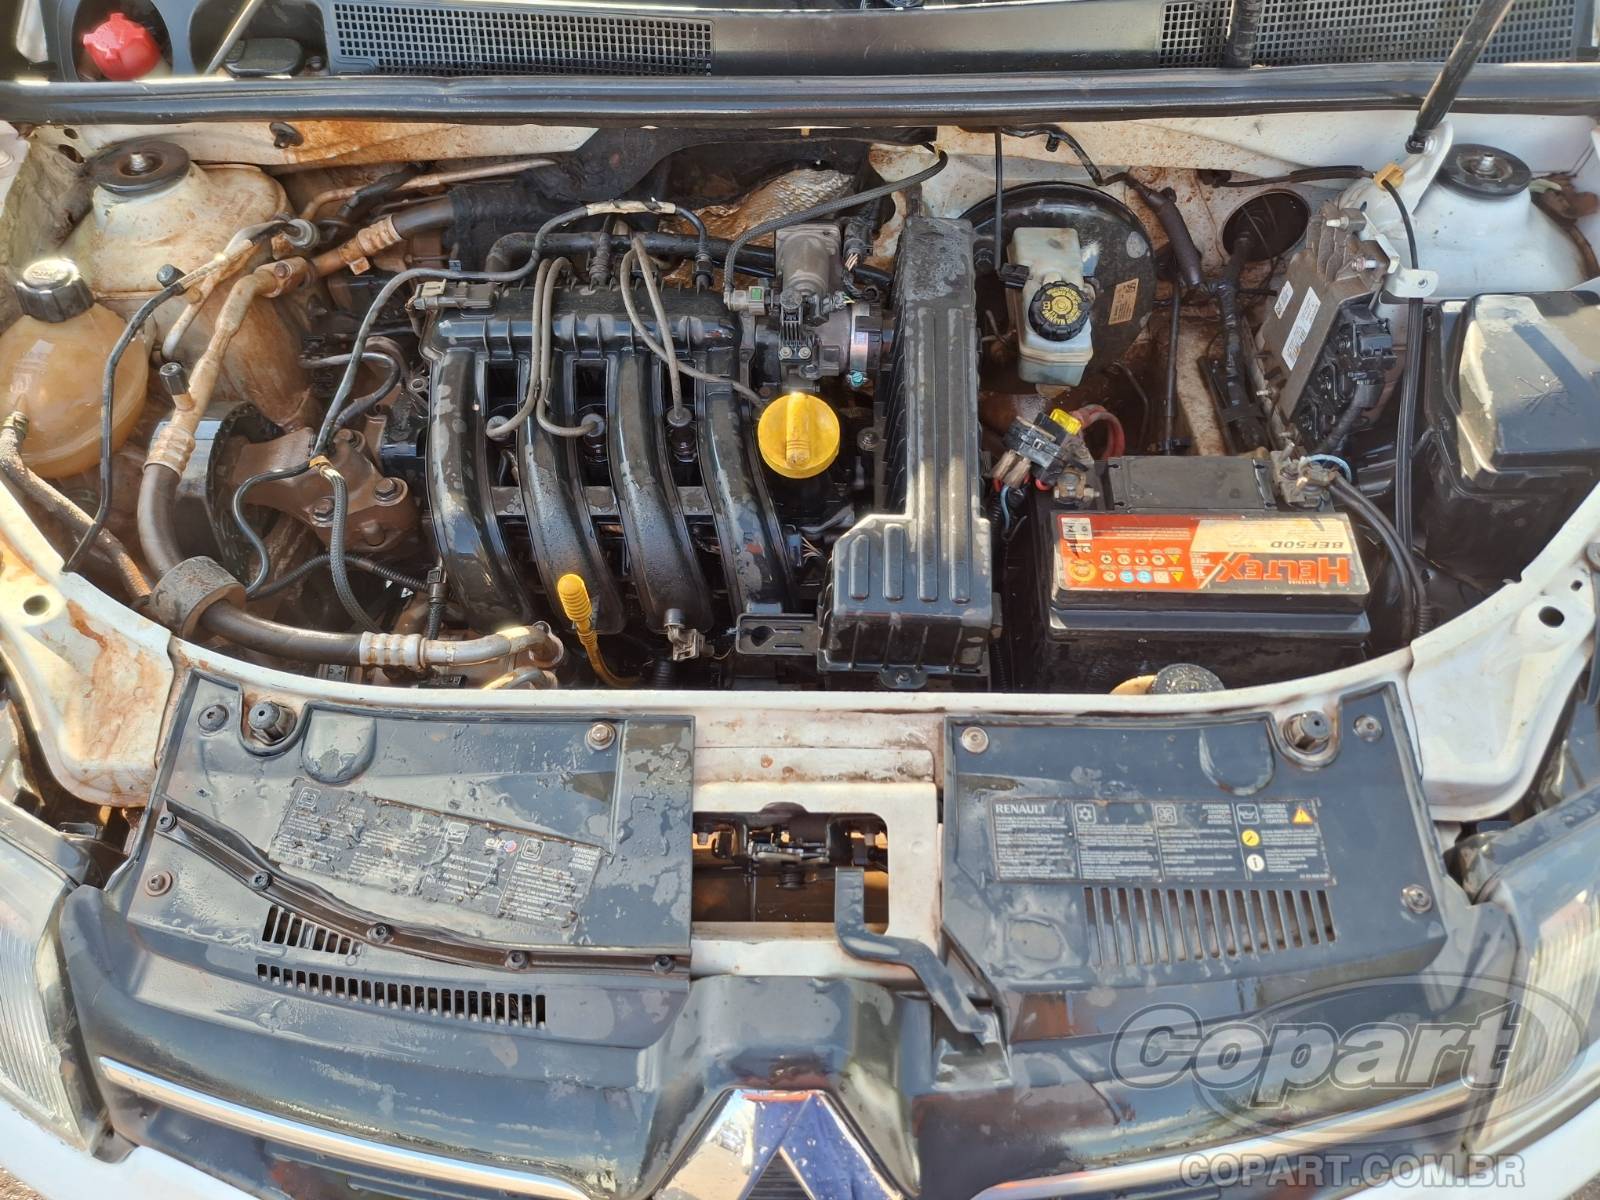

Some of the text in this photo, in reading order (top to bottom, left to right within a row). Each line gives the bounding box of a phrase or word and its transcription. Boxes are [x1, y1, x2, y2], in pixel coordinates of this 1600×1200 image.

[1270, 541, 1344, 549] BEF50D
[1216, 553, 1350, 584] HELTEX
[995, 803, 1046, 815] RENAULT
